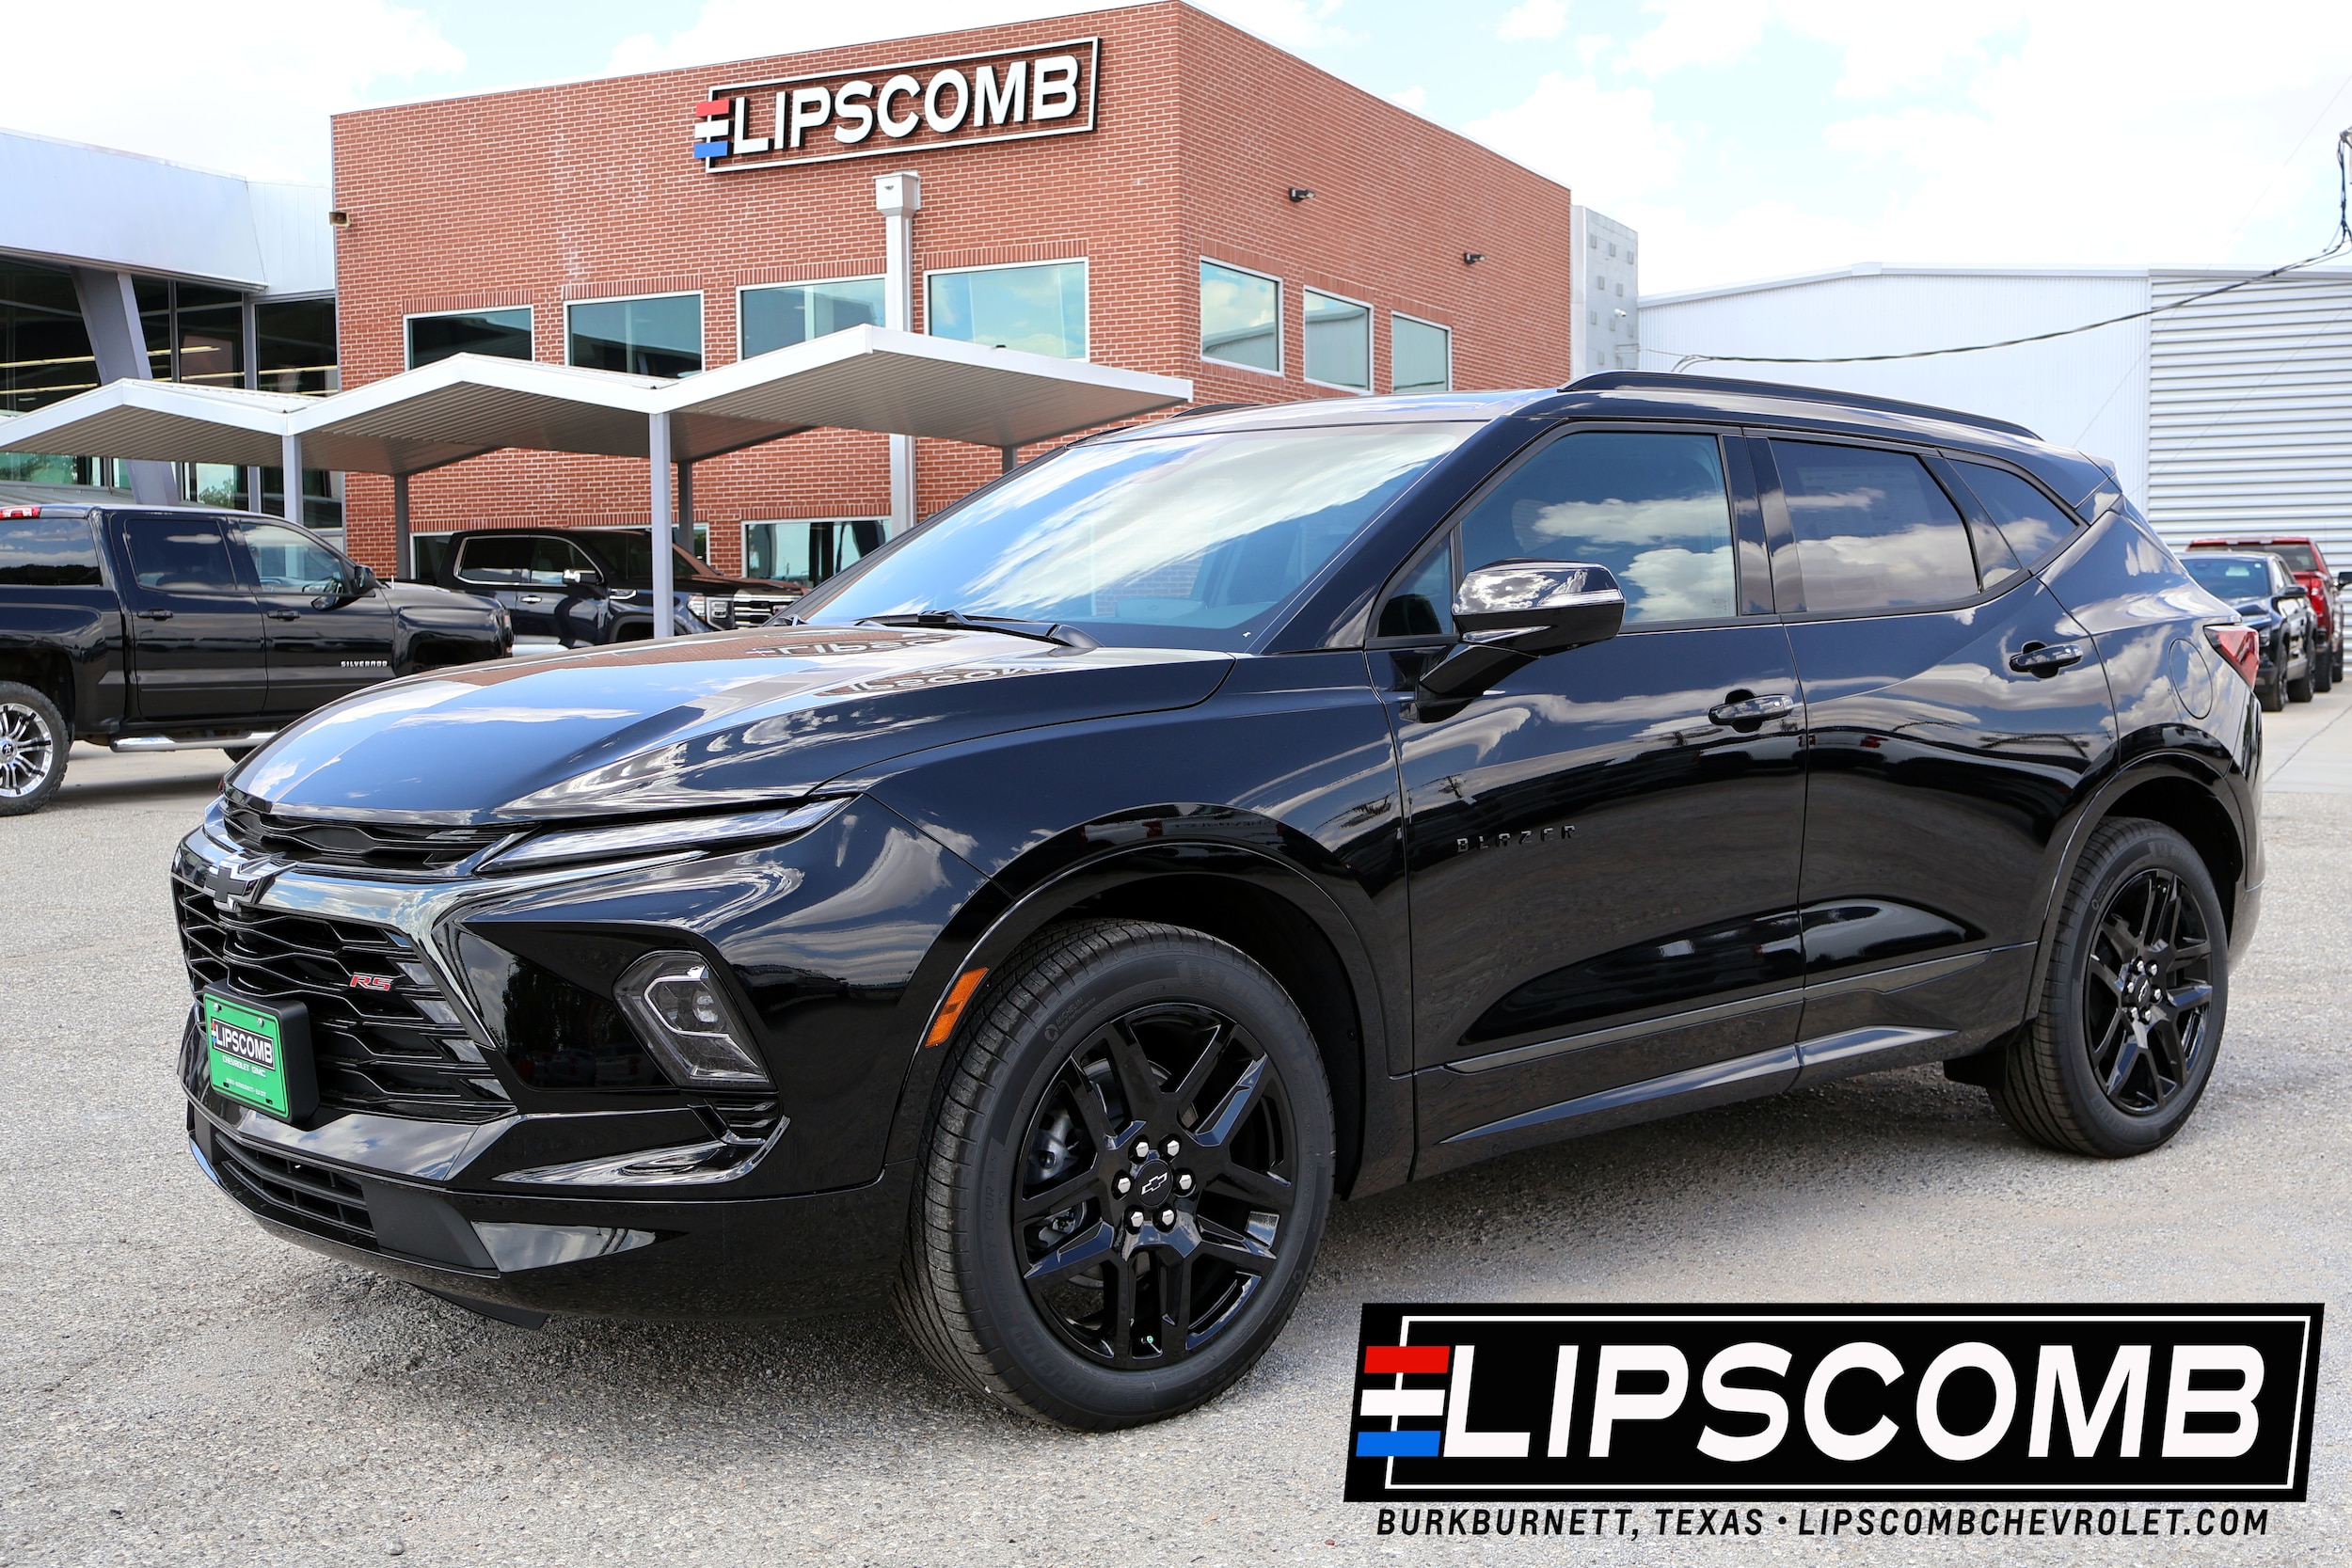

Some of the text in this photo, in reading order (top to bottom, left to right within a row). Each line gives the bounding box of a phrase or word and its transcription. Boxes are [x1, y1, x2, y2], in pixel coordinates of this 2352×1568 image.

[733, 55, 1081, 156] LIPSCOMB
[1455, 824, 1576, 853] BLAZER
[349, 974, 394, 991] RS
[1056, 997, 1083, 1026] MICHELIN
[215, 1024, 273, 1064] LIPSCOMB
[222, 1054, 267, 1078] CHEVROLET GMC
[983, 1183, 995, 1231] TOUR
